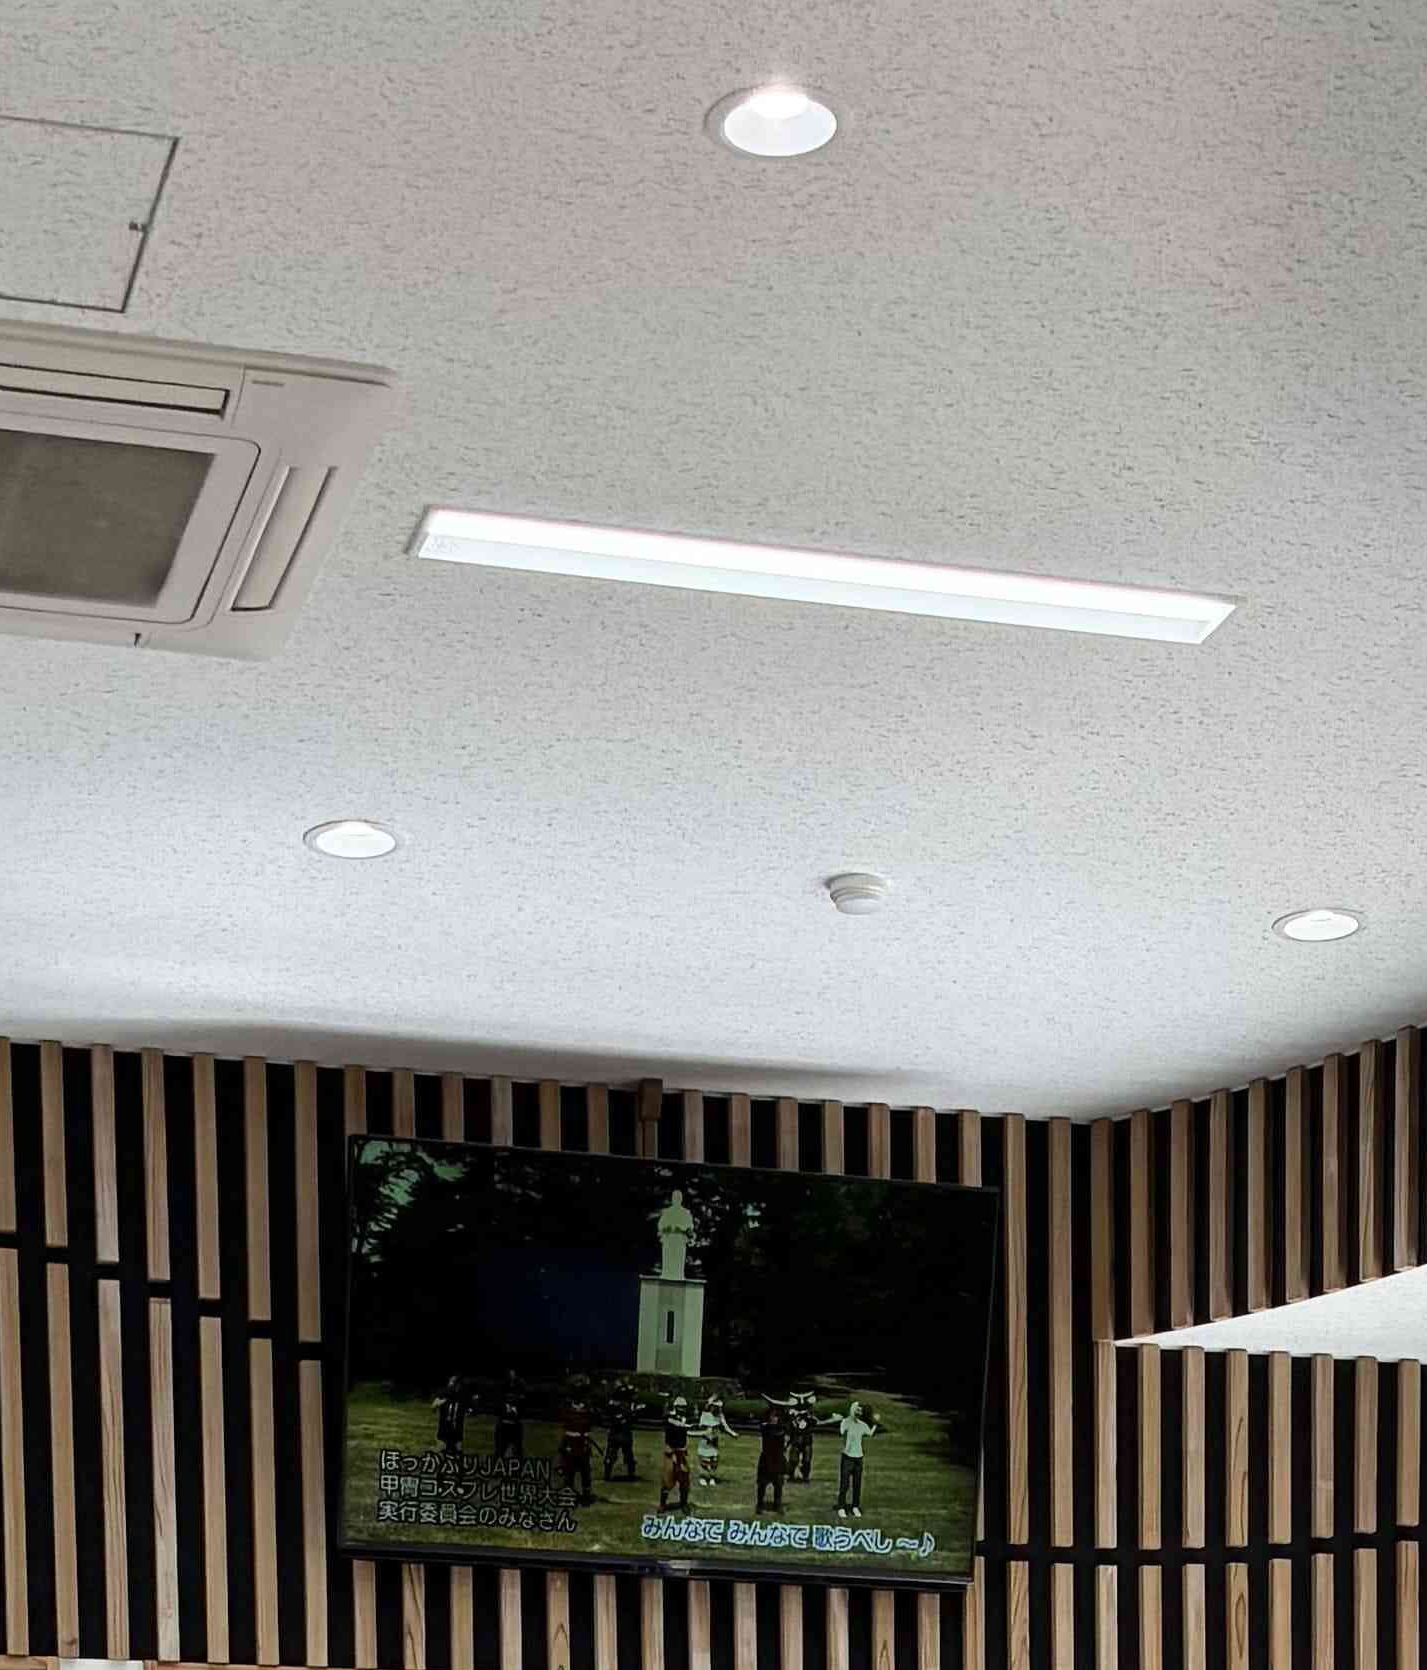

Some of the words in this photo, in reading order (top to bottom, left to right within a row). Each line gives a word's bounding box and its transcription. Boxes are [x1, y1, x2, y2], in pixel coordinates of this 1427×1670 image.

[378, 1500, 575, 1532] 実行委員会のみなさん
[640, 1514, 725, 1543] みんなで
[727, 1519, 809, 1549] みんなで
